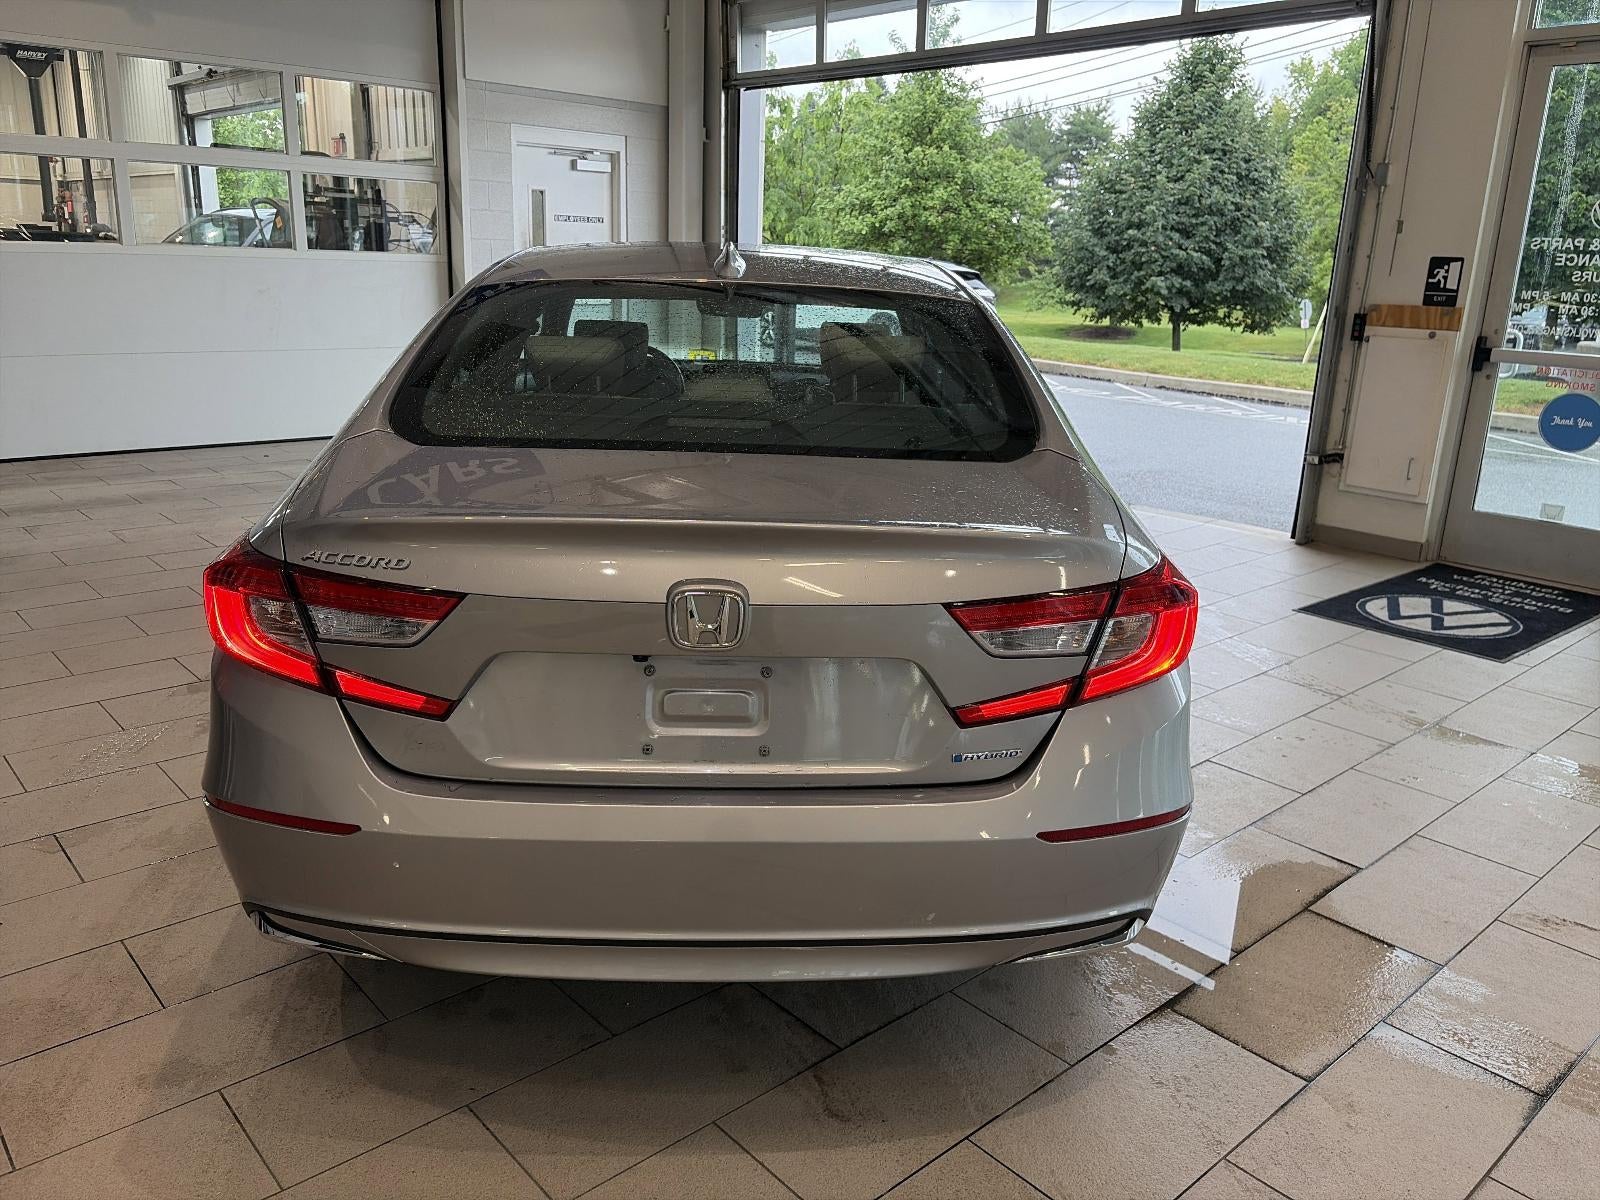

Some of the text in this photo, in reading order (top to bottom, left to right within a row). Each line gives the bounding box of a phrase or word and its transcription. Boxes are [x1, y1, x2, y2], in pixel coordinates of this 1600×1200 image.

[1550, 415, 1593, 429] Thank You
[301, 550, 412, 571] ACCORD
[1453, 574, 1571, 602] Volkswagen
[961, 749, 1020, 762] HYBRID
